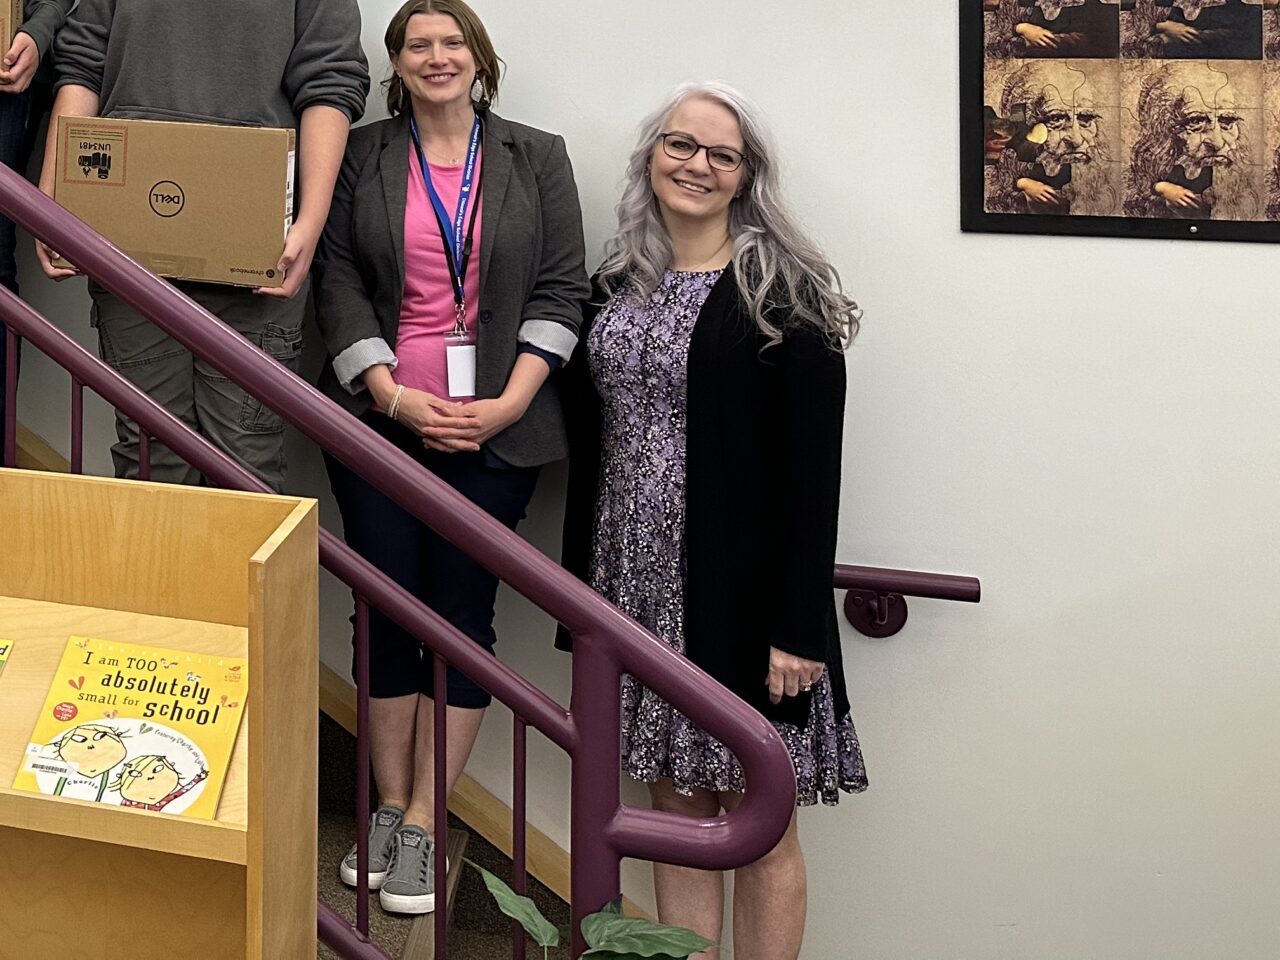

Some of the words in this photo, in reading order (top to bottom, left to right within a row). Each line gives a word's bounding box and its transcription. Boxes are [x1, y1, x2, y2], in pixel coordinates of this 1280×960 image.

[79, 141, 111, 151] UN3481
[153, 193, 180, 204] DELL
[83, 651, 94, 665] I
[98, 656, 119, 668] am
[126, 657, 158, 672] TOO
[100, 670, 211, 705] absolutely
[77, 690, 117, 706] small
[122, 696, 140, 707] for
[142, 700, 220, 726] school
